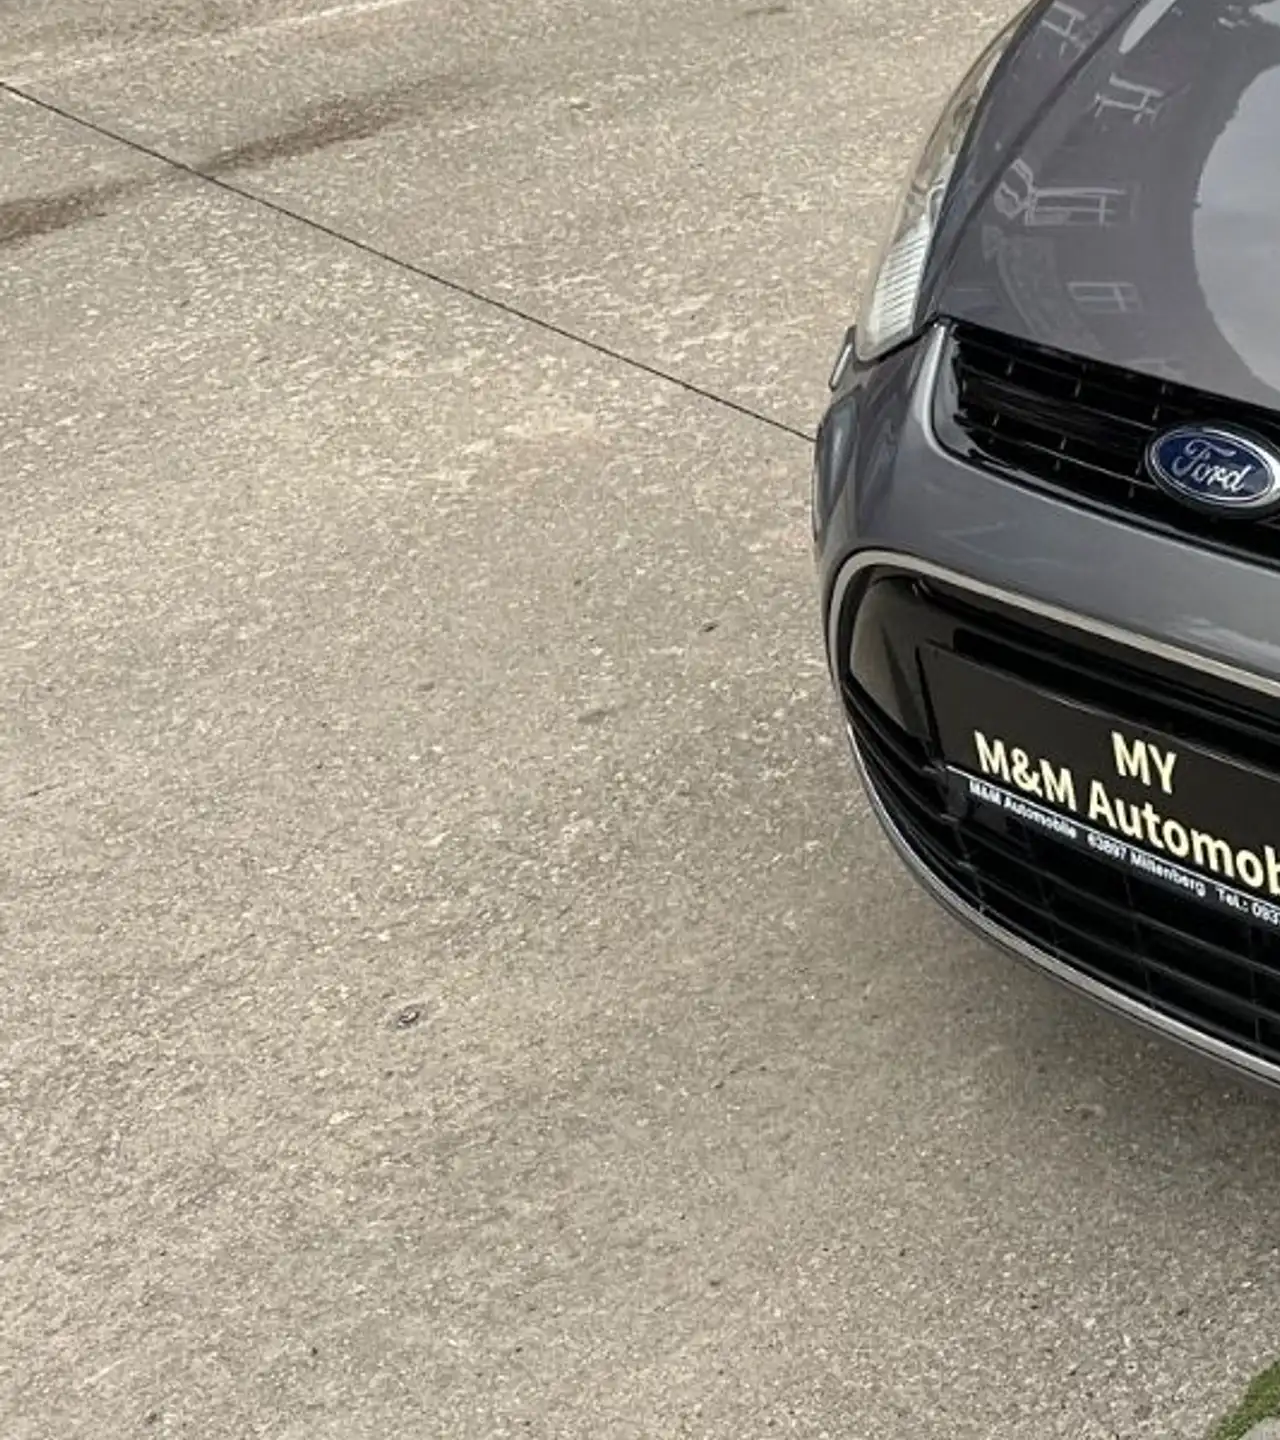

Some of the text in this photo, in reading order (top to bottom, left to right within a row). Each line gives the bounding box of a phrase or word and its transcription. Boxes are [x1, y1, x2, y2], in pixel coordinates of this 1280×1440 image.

[1171, 438, 1255, 492] Ford
[974, 729, 1077, 812] M&M
[1111, 730, 1177, 795] MY
